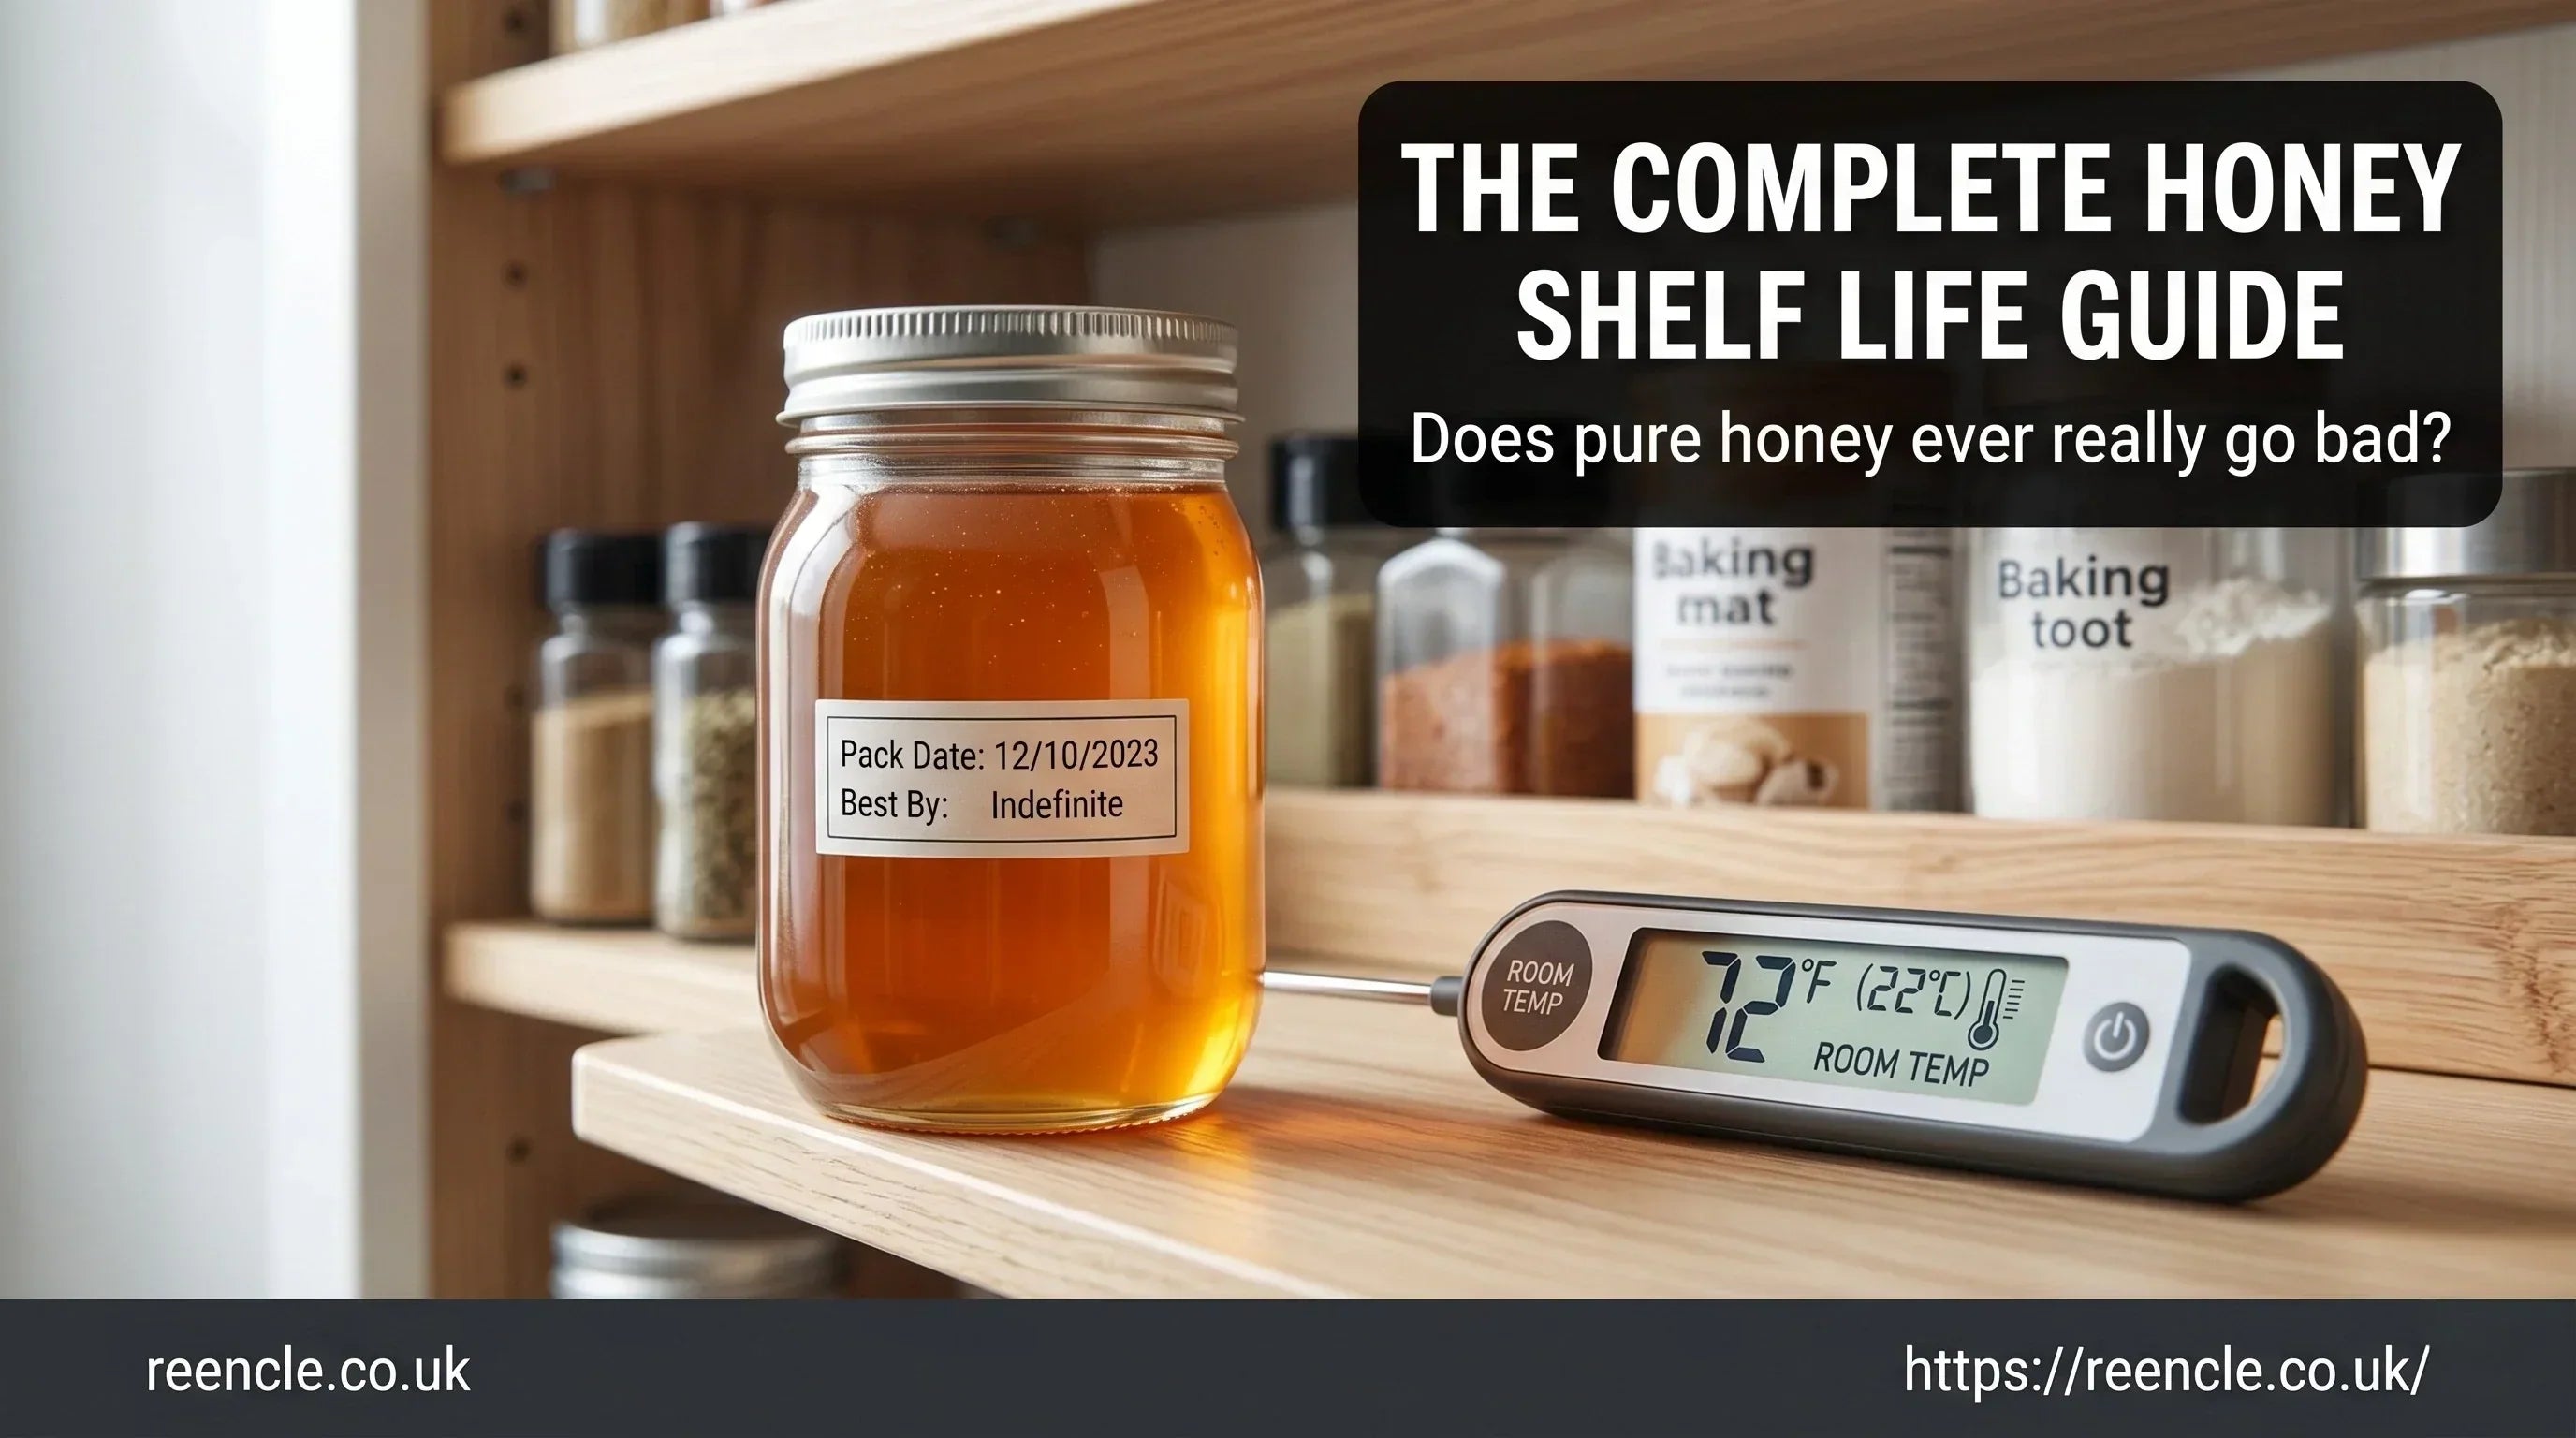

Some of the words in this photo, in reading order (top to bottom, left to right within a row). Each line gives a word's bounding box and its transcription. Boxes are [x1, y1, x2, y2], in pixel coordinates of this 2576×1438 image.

[1998, 554, 2171, 606] Baking
[1677, 589, 1775, 625] mat
[2032, 609, 2132, 648] toot
[841, 739, 905, 770] Pack
[914, 740, 985, 770] Date:
[995, 737, 1160, 772] 12/10/2023
[842, 787, 899, 818] Best
[907, 788, 948, 827] By:
[991, 788, 1124, 820] Indefinite
[1507, 960, 1574, 987] ROOM
[1503, 989, 1564, 1016] TEMP
[1813, 1041, 1901, 1079] ROOM
[1910, 1050, 1990, 1087] TEMP
